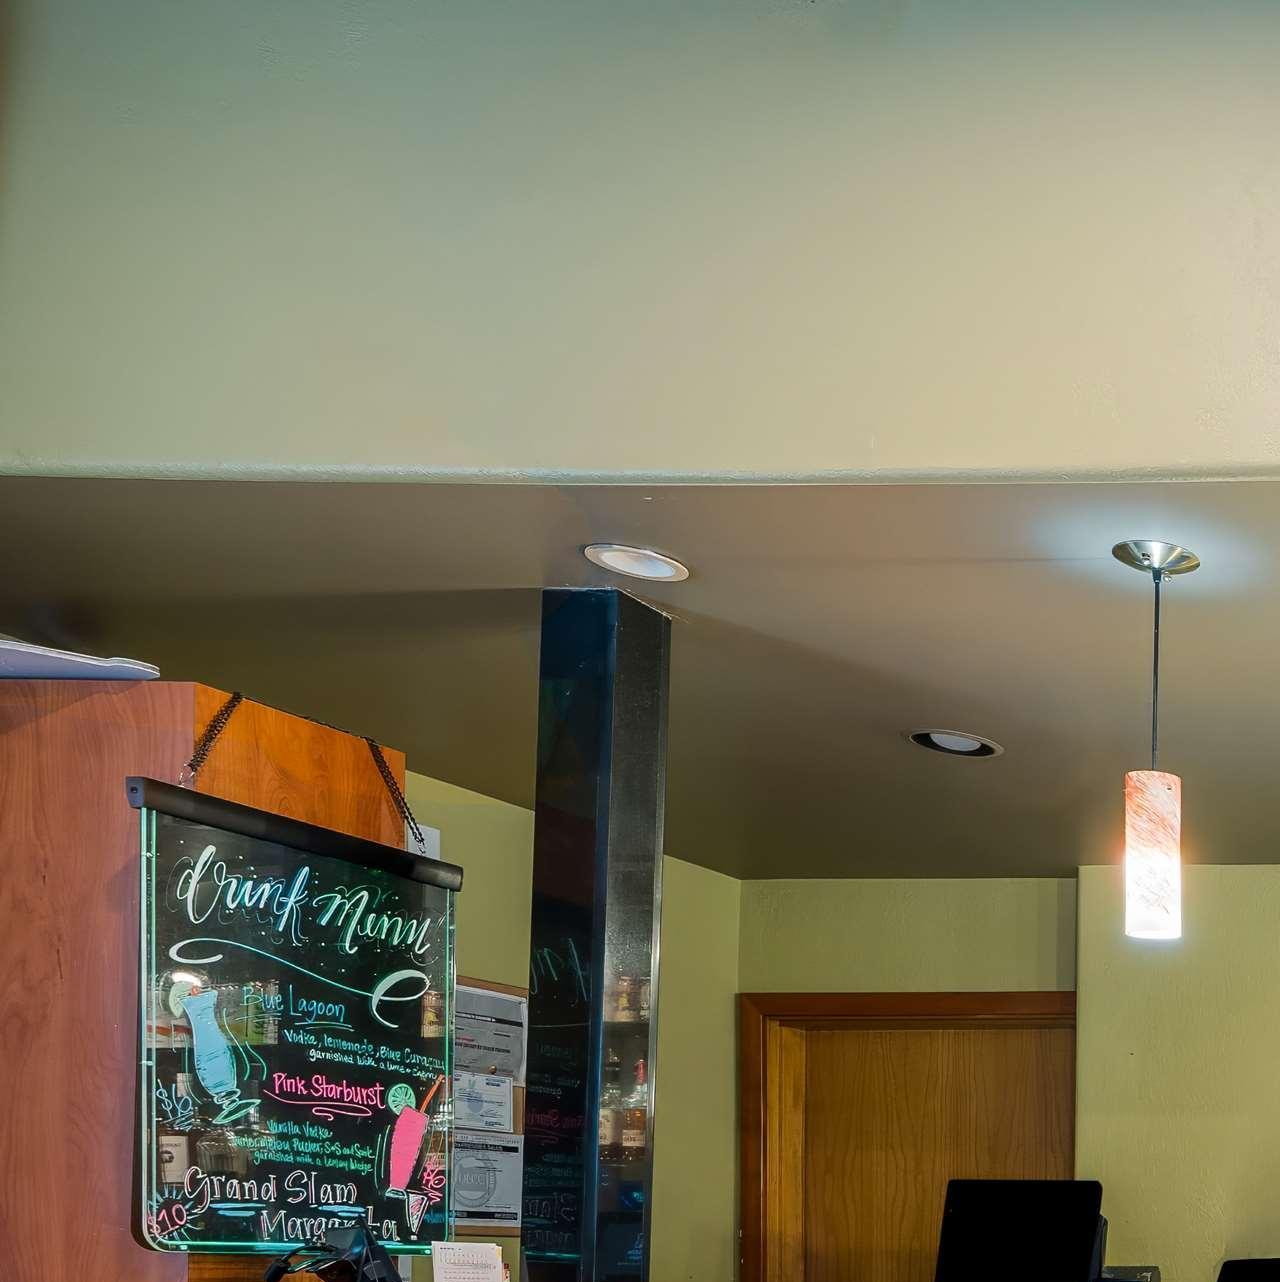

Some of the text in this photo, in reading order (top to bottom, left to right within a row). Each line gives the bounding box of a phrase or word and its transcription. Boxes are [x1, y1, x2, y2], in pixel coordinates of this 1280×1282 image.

[239, 984, 346, 1022] Blue Lagoon
[272, 1072, 387, 1110] Pink Starburst
[184, 1166, 358, 1214] Grand Slam
[147, 1203, 188, 1236] $10
